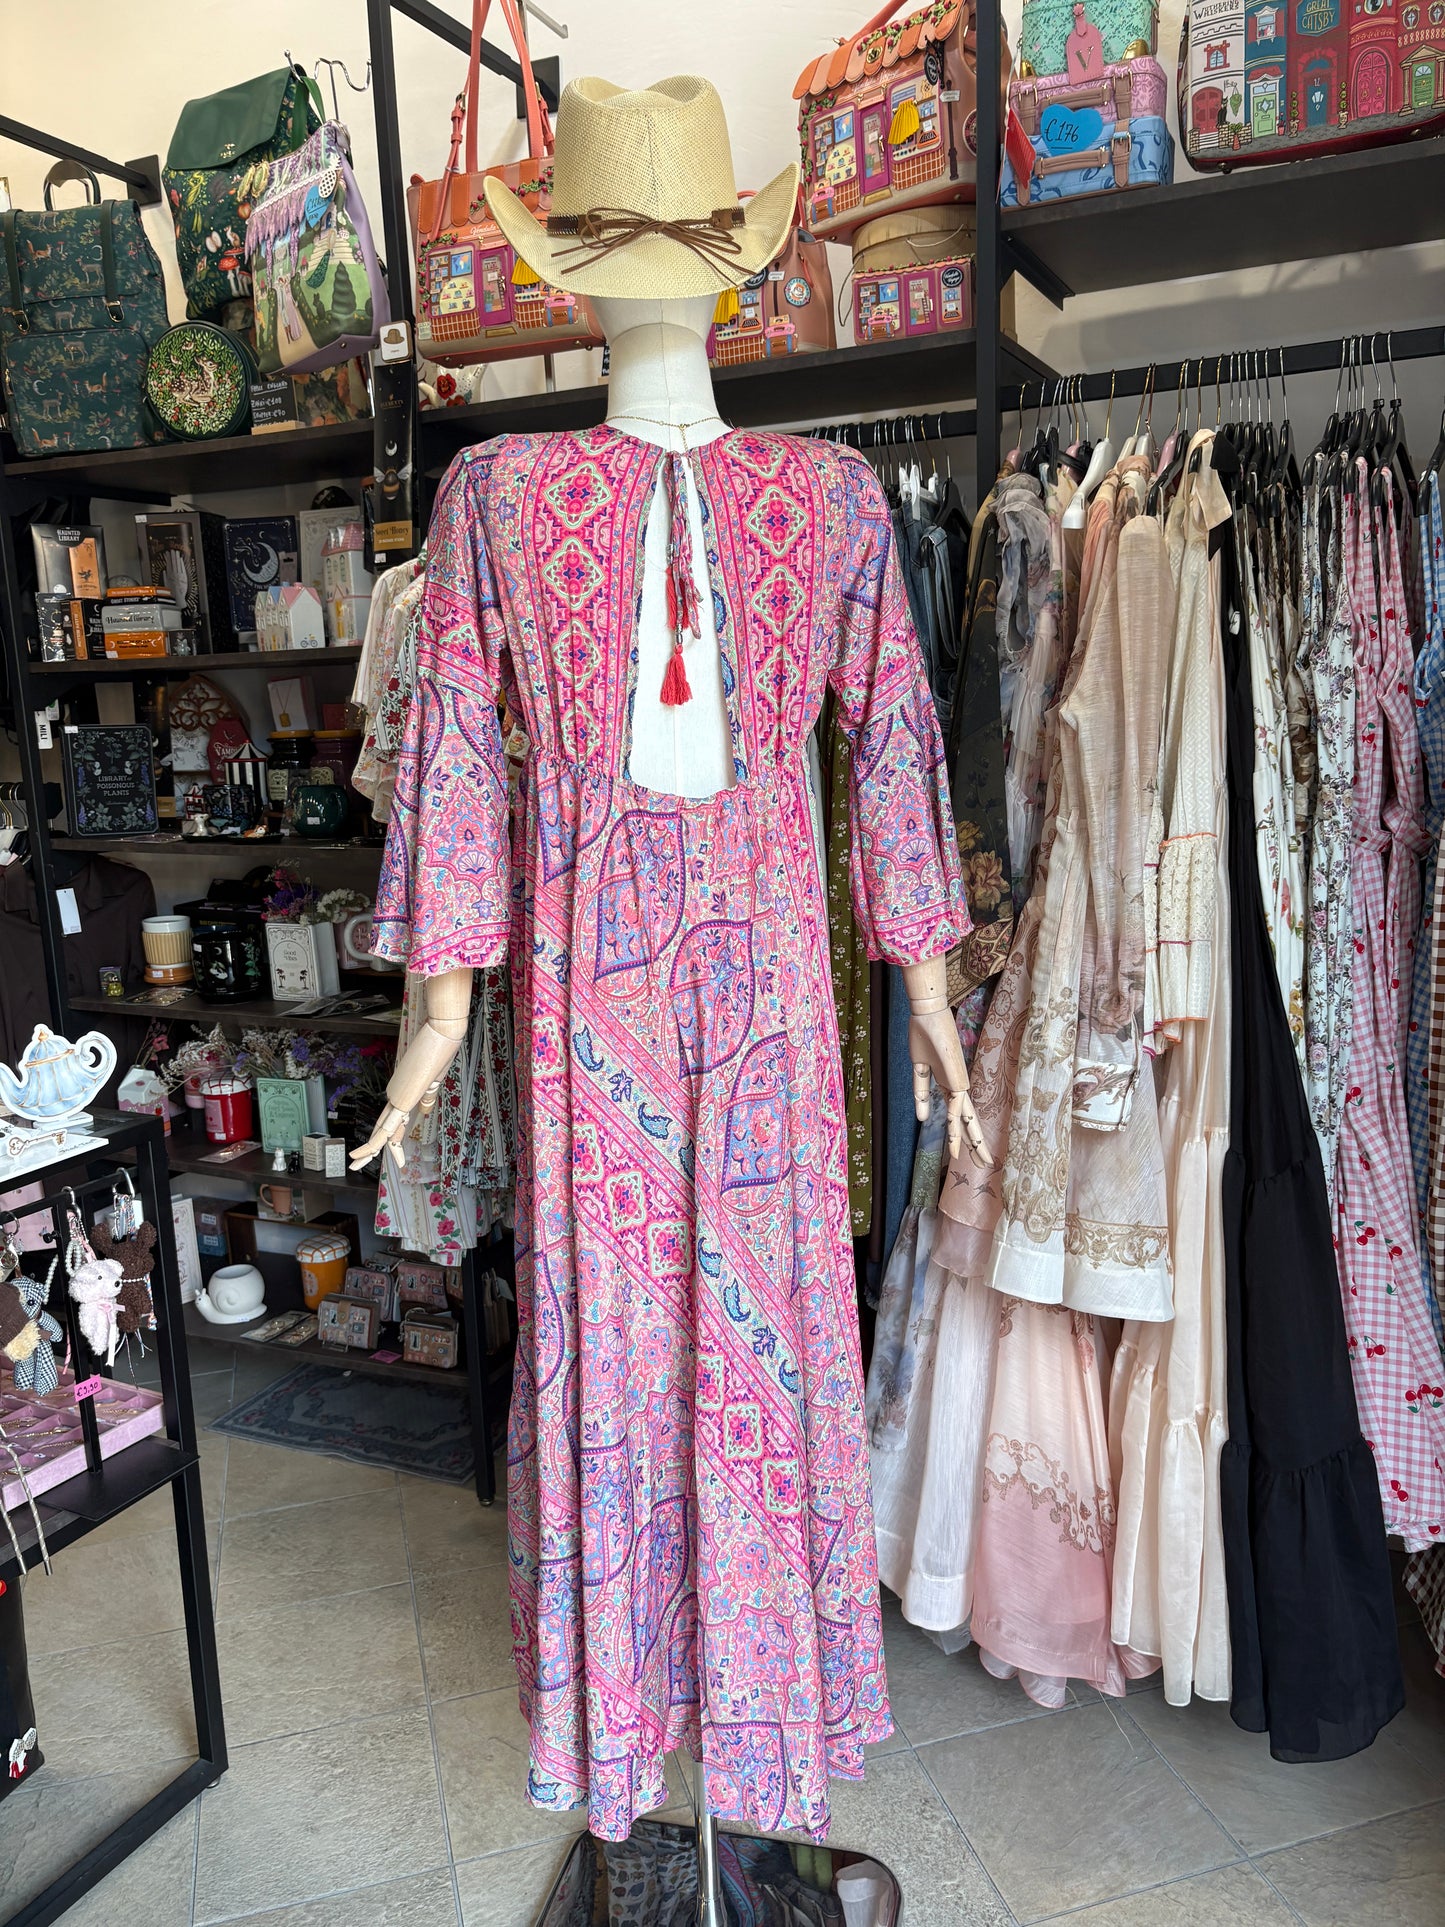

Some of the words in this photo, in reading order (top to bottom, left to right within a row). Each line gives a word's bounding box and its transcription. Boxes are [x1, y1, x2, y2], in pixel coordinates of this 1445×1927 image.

[1302, 11, 1336, 30] CATSBY
[1074, 45, 1095, 72] V
[1044, 119, 1079, 142] €176
